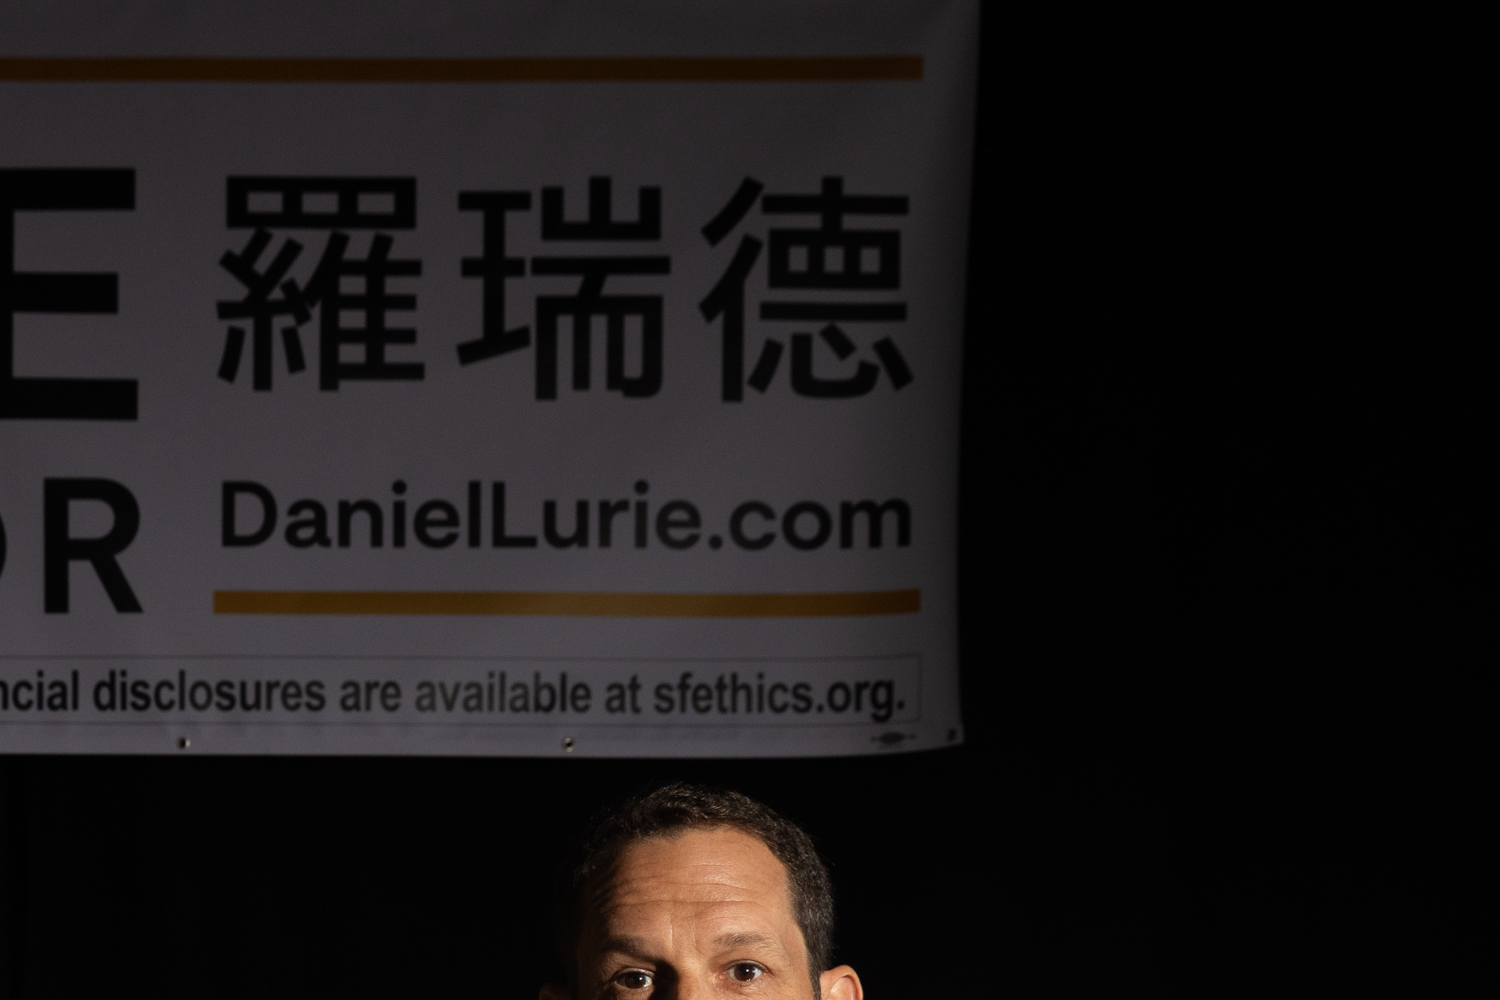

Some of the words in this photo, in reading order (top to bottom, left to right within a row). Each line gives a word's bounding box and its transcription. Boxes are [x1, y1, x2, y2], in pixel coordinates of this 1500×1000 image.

[217, 176, 913, 402] 羅瑞德
[222, 480, 912, 551] DanielLurie.com
[93, 669, 326, 712] disclosures
[340, 681, 401, 712] are
[416, 672, 592, 713] available
[605, 675, 641, 714] at
[654, 671, 906, 725] sfethics.org.
